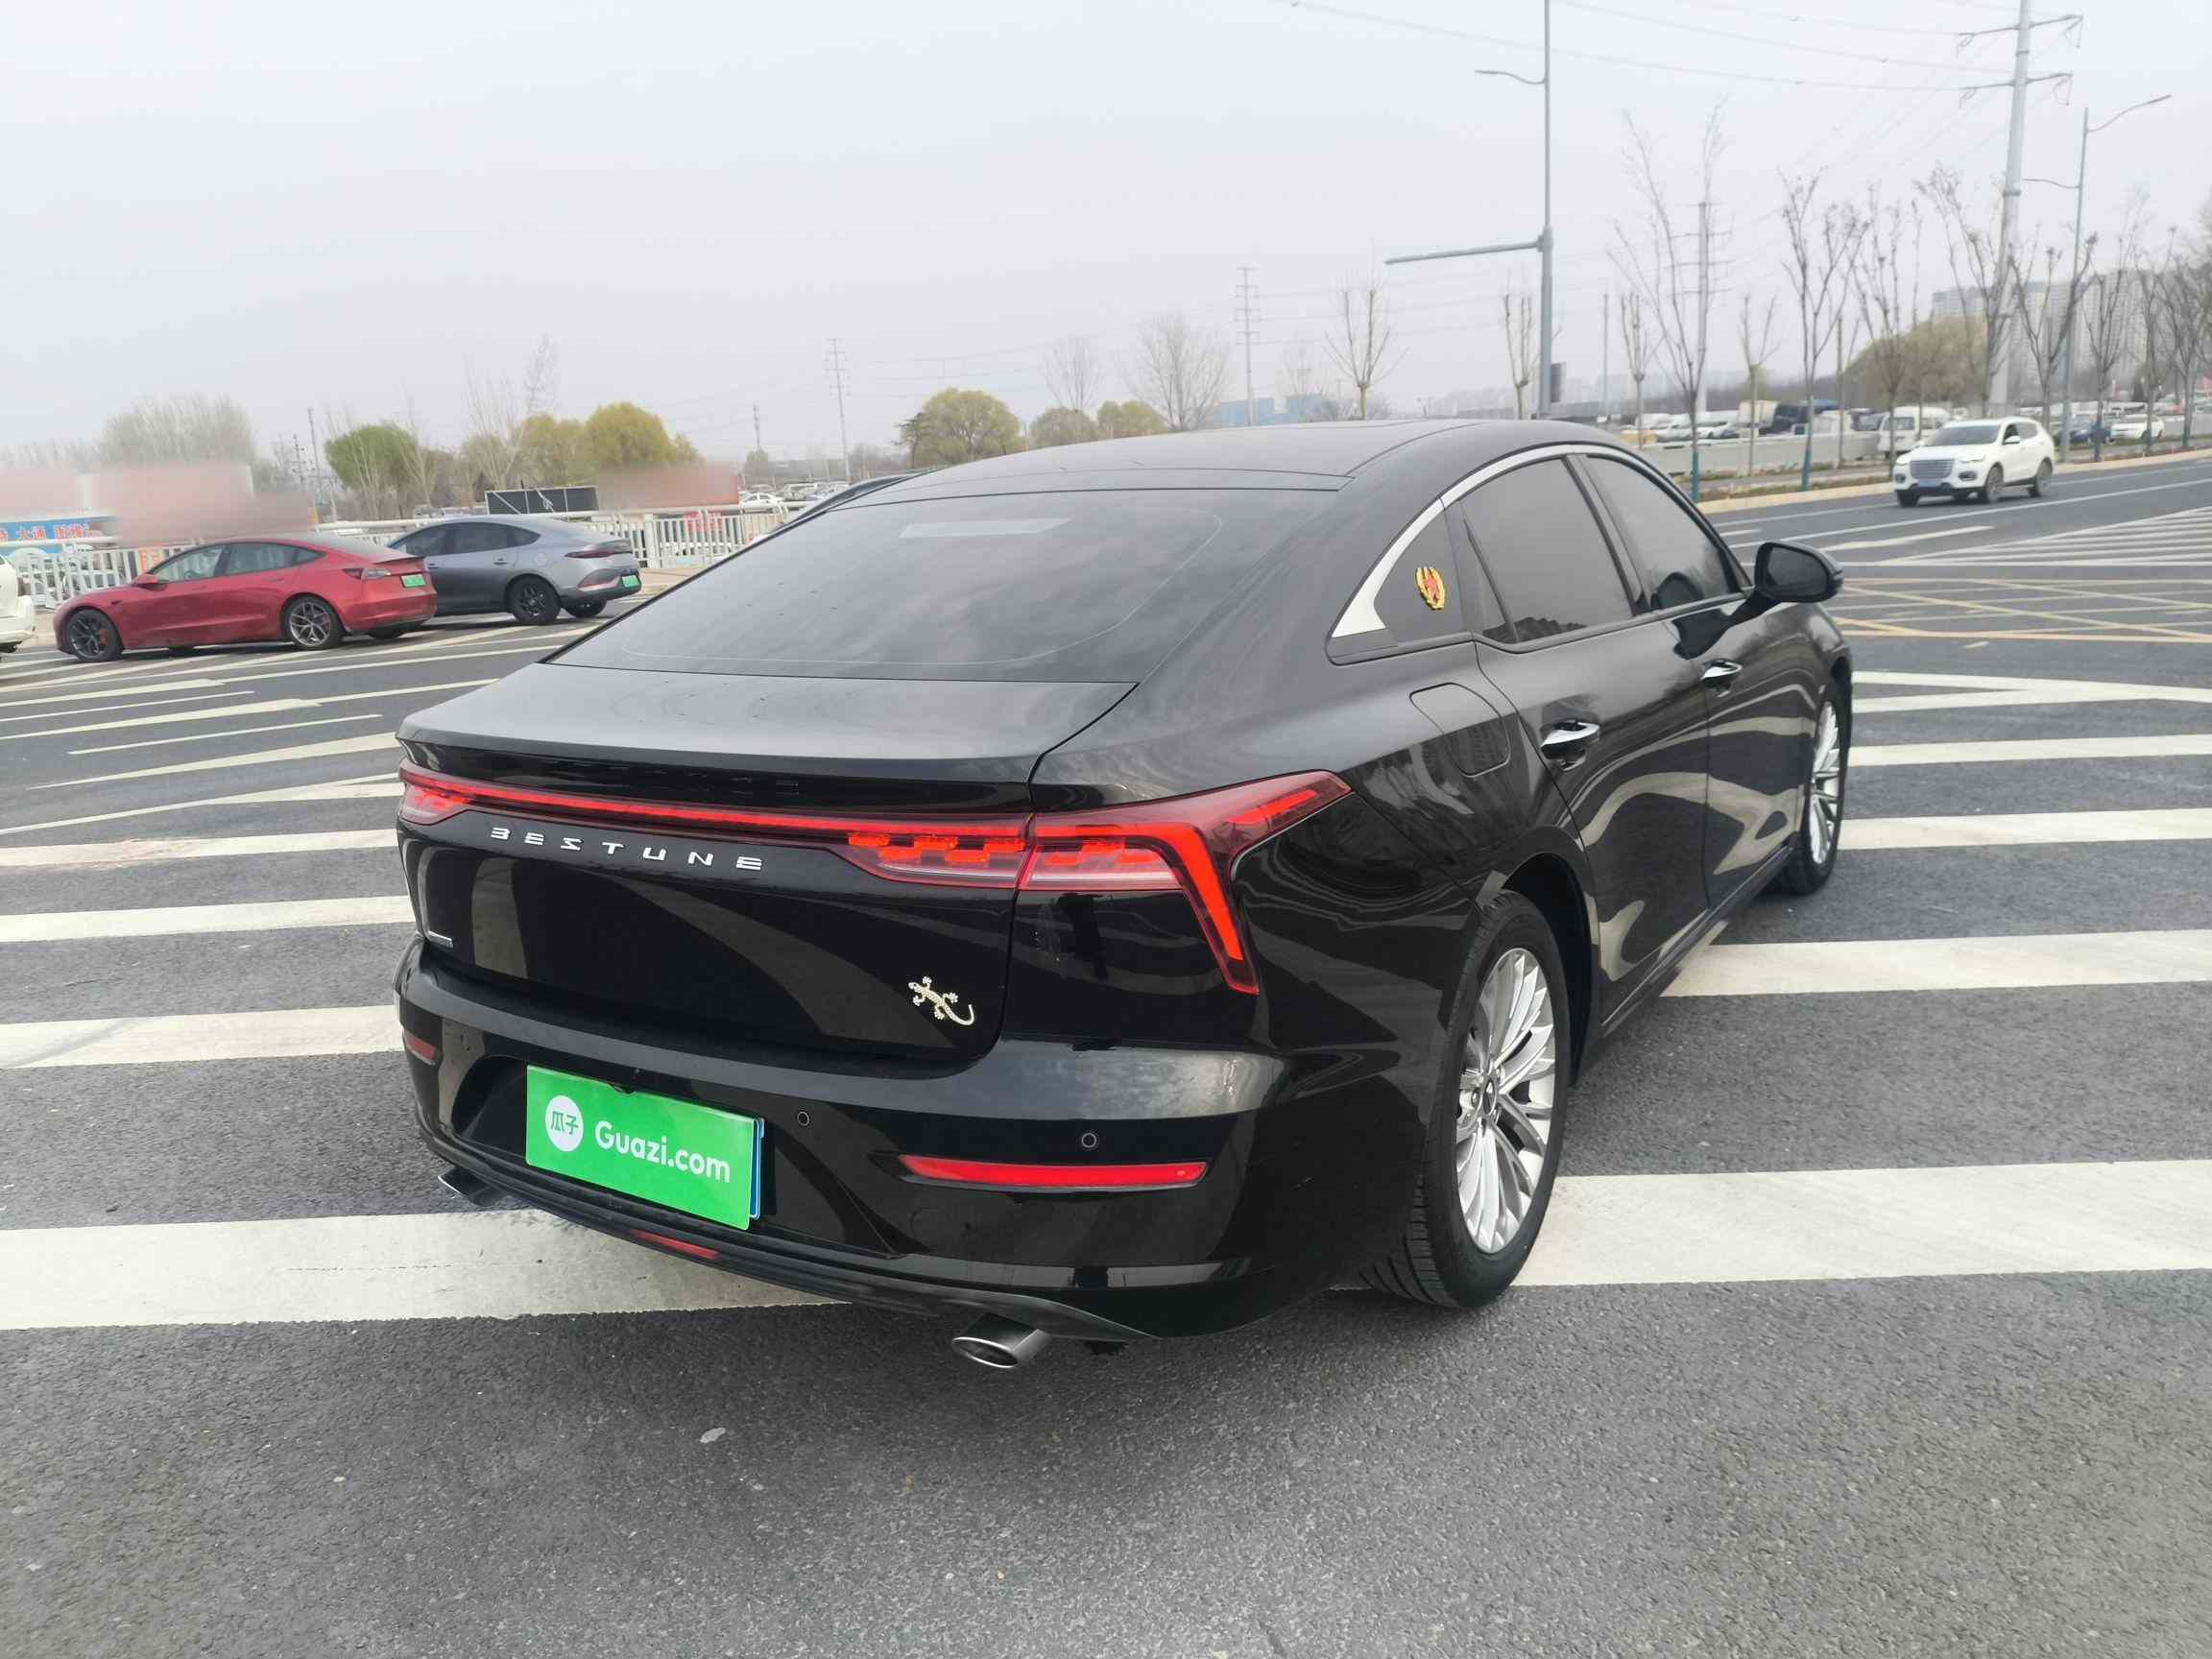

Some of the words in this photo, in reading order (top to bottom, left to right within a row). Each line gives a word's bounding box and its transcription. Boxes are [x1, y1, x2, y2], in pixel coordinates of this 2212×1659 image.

[491, 827, 762, 870] BESTUNE
[550, 1110, 579, 1135] 瓜子
[595, 1120, 730, 1183] Guazi.com
